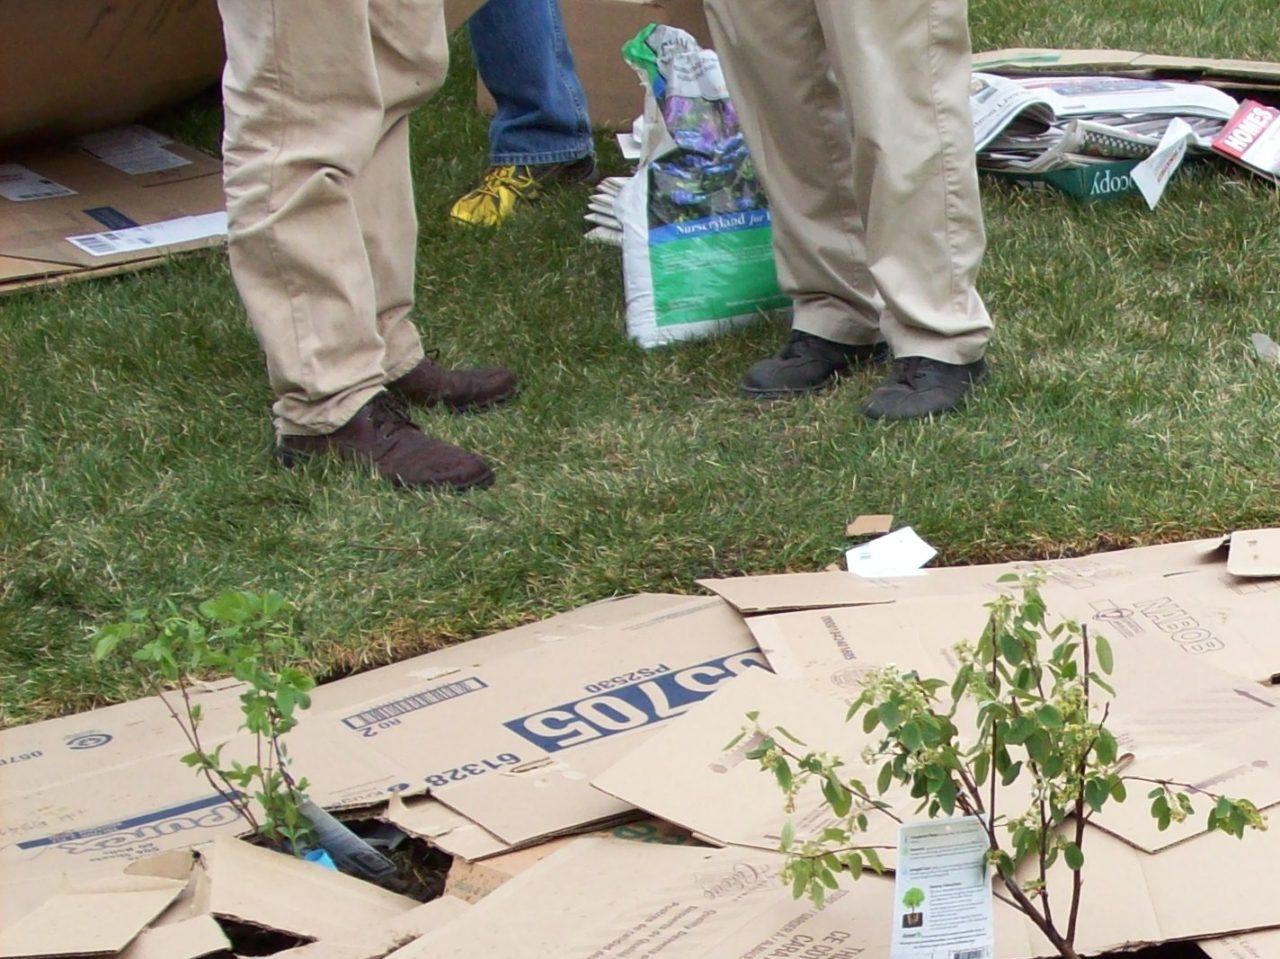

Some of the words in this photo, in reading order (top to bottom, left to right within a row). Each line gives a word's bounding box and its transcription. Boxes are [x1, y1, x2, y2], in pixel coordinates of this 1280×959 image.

[1224, 106, 1276, 152] HOMES
[1089, 169, 1137, 196] copy
[676, 212, 746, 236] Nurseryland
[1133, 597, 1226, 655] NABOB
[585, 663, 672, 694] PS2530
[424, 752, 522, 788] 61328
[768, 934, 814, 958] CARA
[822, 930, 851, 945] CE
